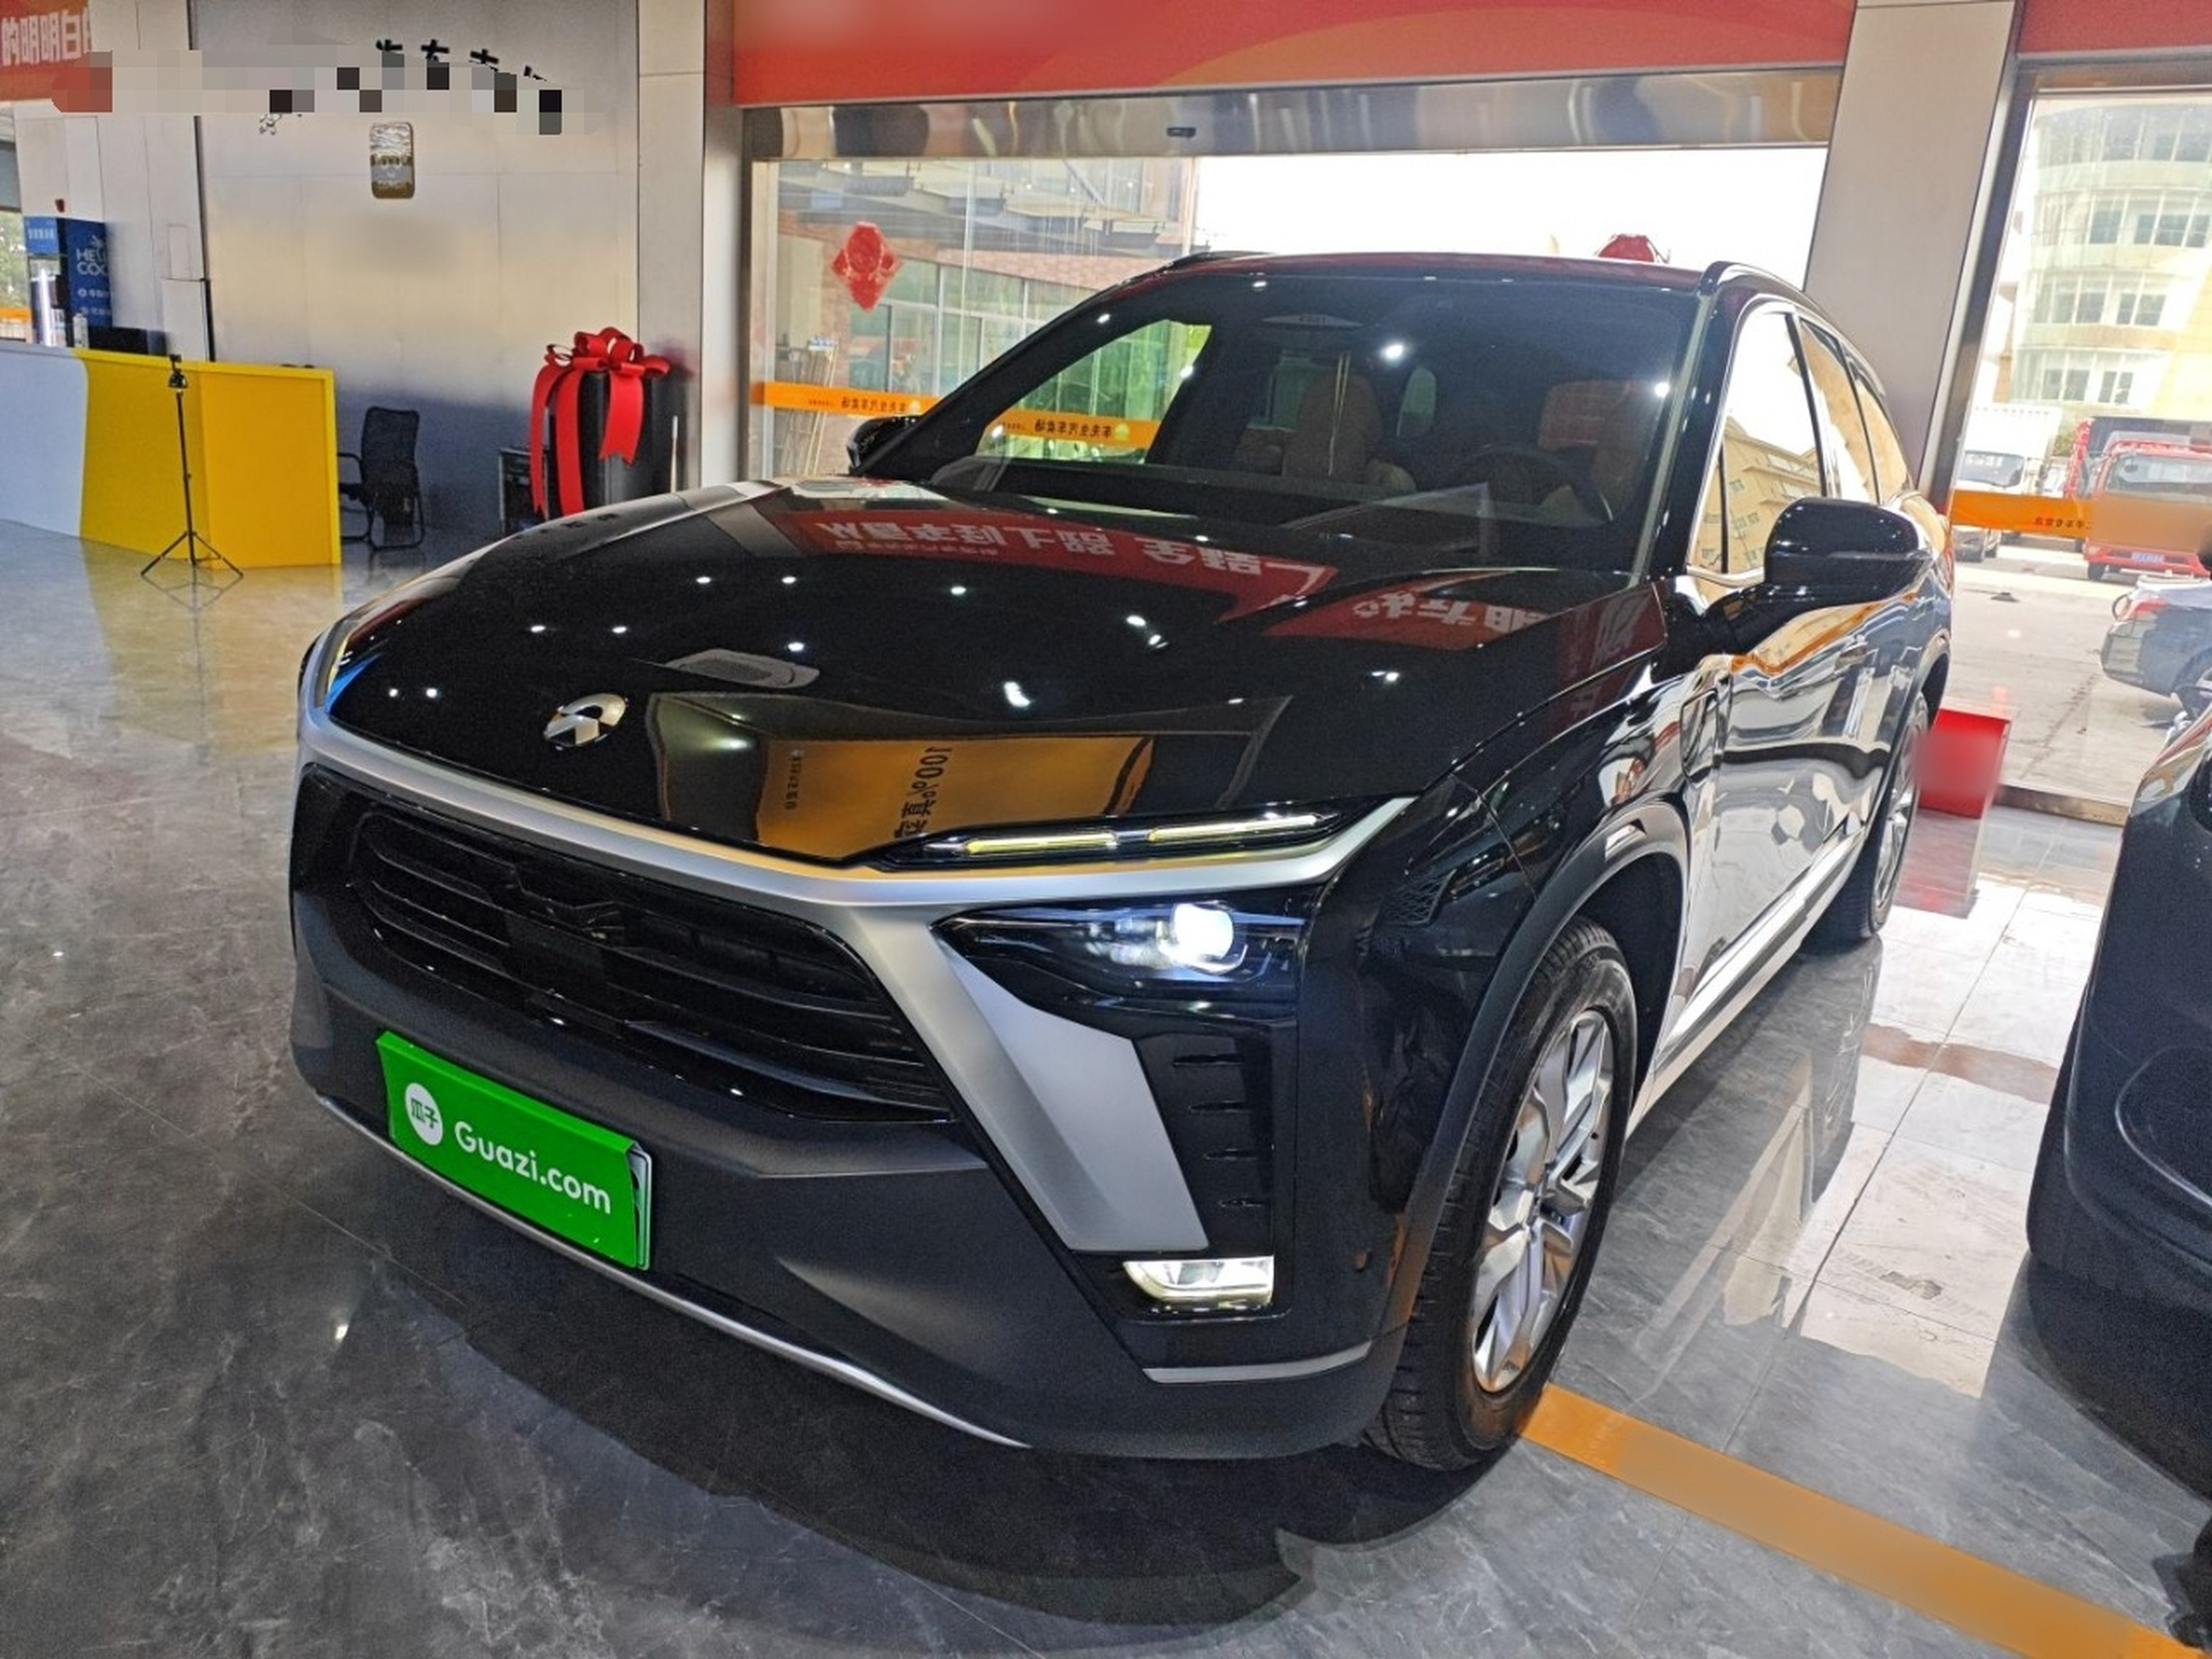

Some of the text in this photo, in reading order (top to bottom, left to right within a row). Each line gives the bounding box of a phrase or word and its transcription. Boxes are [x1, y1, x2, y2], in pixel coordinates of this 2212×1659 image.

[2, 7, 90, 66] 的明明白
[411, 1097, 438, 1128] 瓜子
[454, 1121, 611, 1214] Guazi.com
